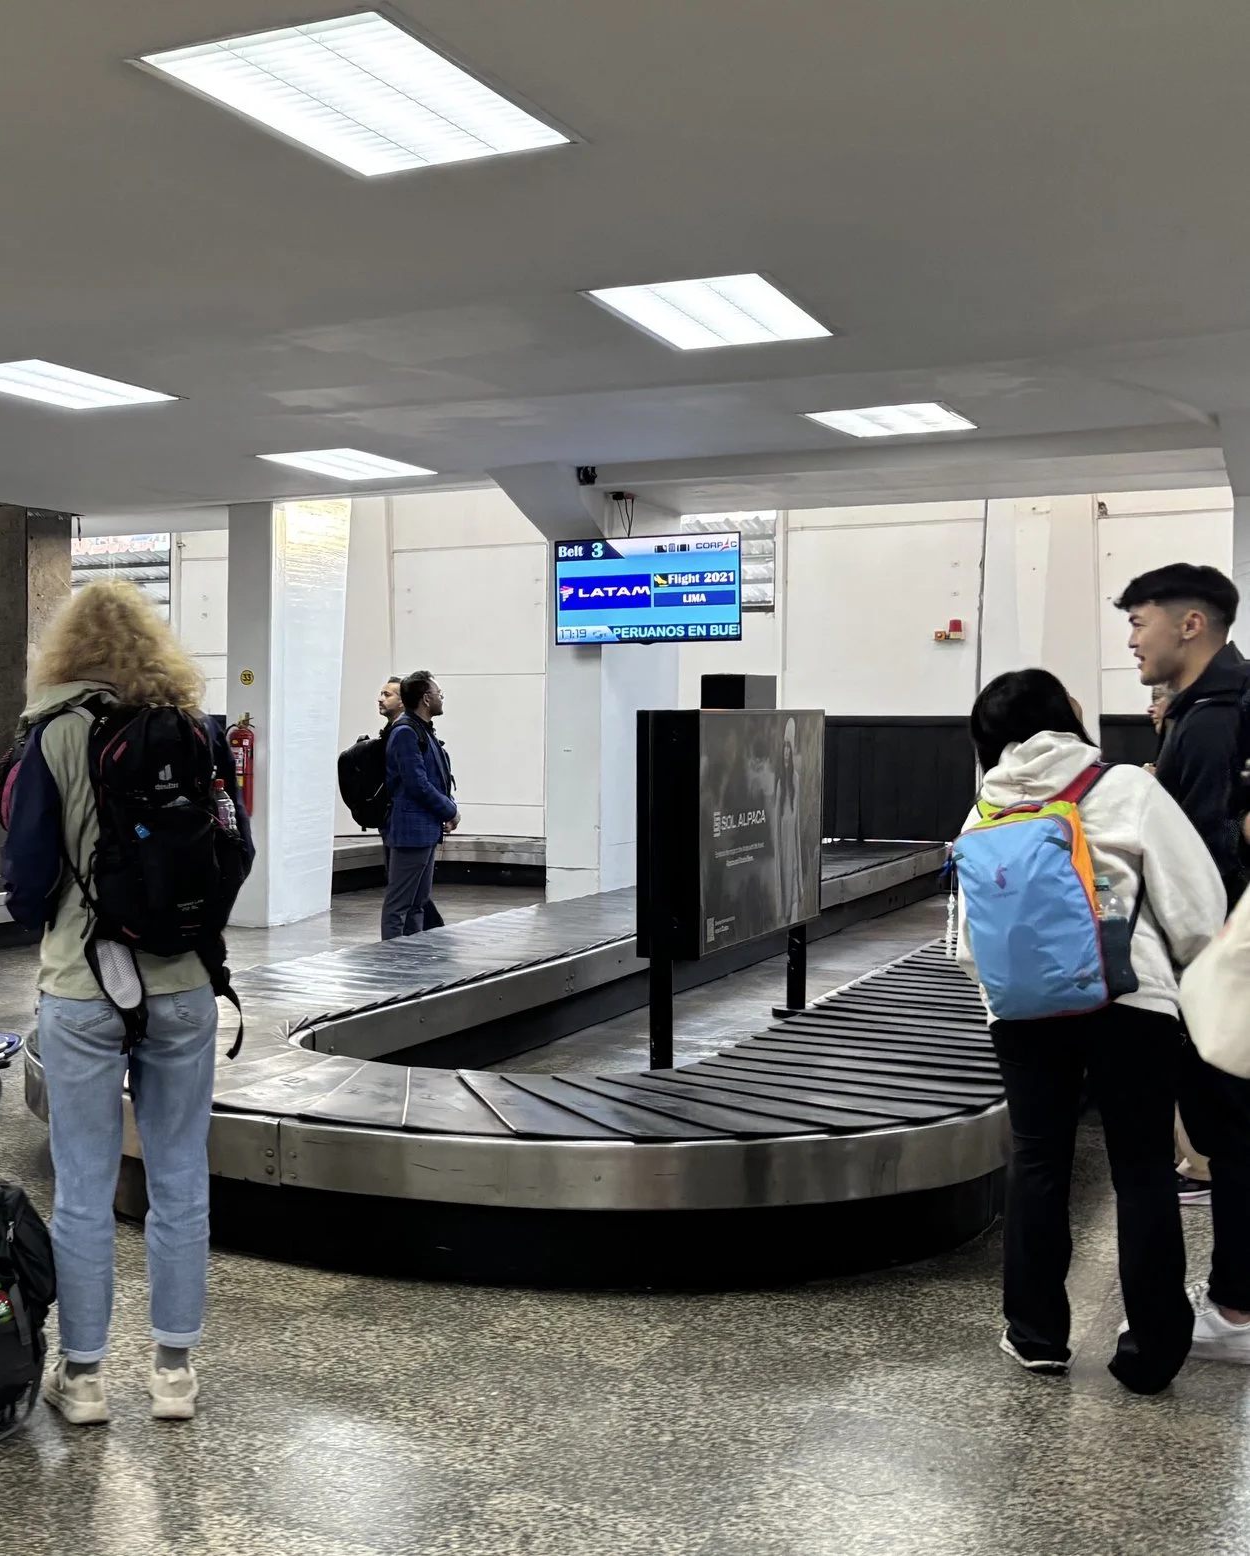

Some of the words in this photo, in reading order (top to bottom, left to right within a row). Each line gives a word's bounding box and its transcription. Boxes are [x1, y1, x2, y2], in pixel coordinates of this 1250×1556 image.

[558, 545, 583, 558] Belt
[591, 542, 604, 558] 3
[668, 573, 700, 586] Flight
[703, 571, 735, 583] 2021
[578, 585, 650, 598] LATAM
[682, 593, 706, 603] LIMA
[559, 629, 587, 640] 17:19
[613, 626, 685, 639] PERUANOS
[688, 625, 707, 637] EN
[721, 814, 737, 831] SOL
[737, 809, 766, 828] ALPACA
